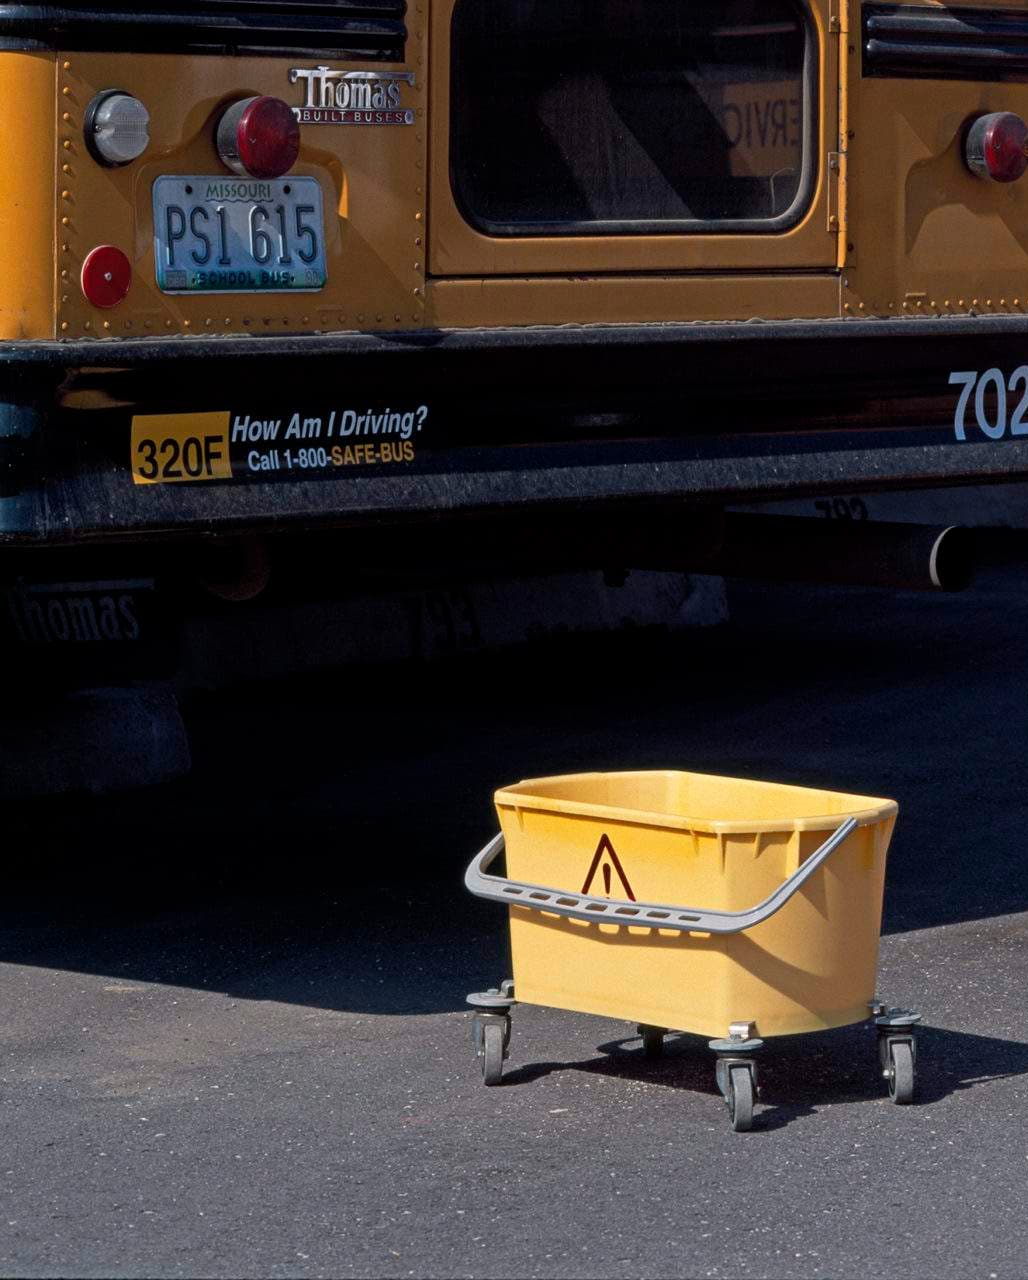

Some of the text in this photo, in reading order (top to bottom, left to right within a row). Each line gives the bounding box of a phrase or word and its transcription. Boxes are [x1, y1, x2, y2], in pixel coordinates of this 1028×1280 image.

[289, 66, 416, 108] Thomas
[303, 110, 403, 122] BUILT BUSES
[205, 183, 272, 200] MISSOURI
[166, 204, 318, 267] PS1 615
[199, 270, 257, 286] SCHOOL
[261, 270, 291, 285] BUS
[231, 404, 429, 443] How Am I Driving?
[136, 434, 224, 480] 320F
[247, 440, 415, 472] Call 1-800-SAFE-BUS
